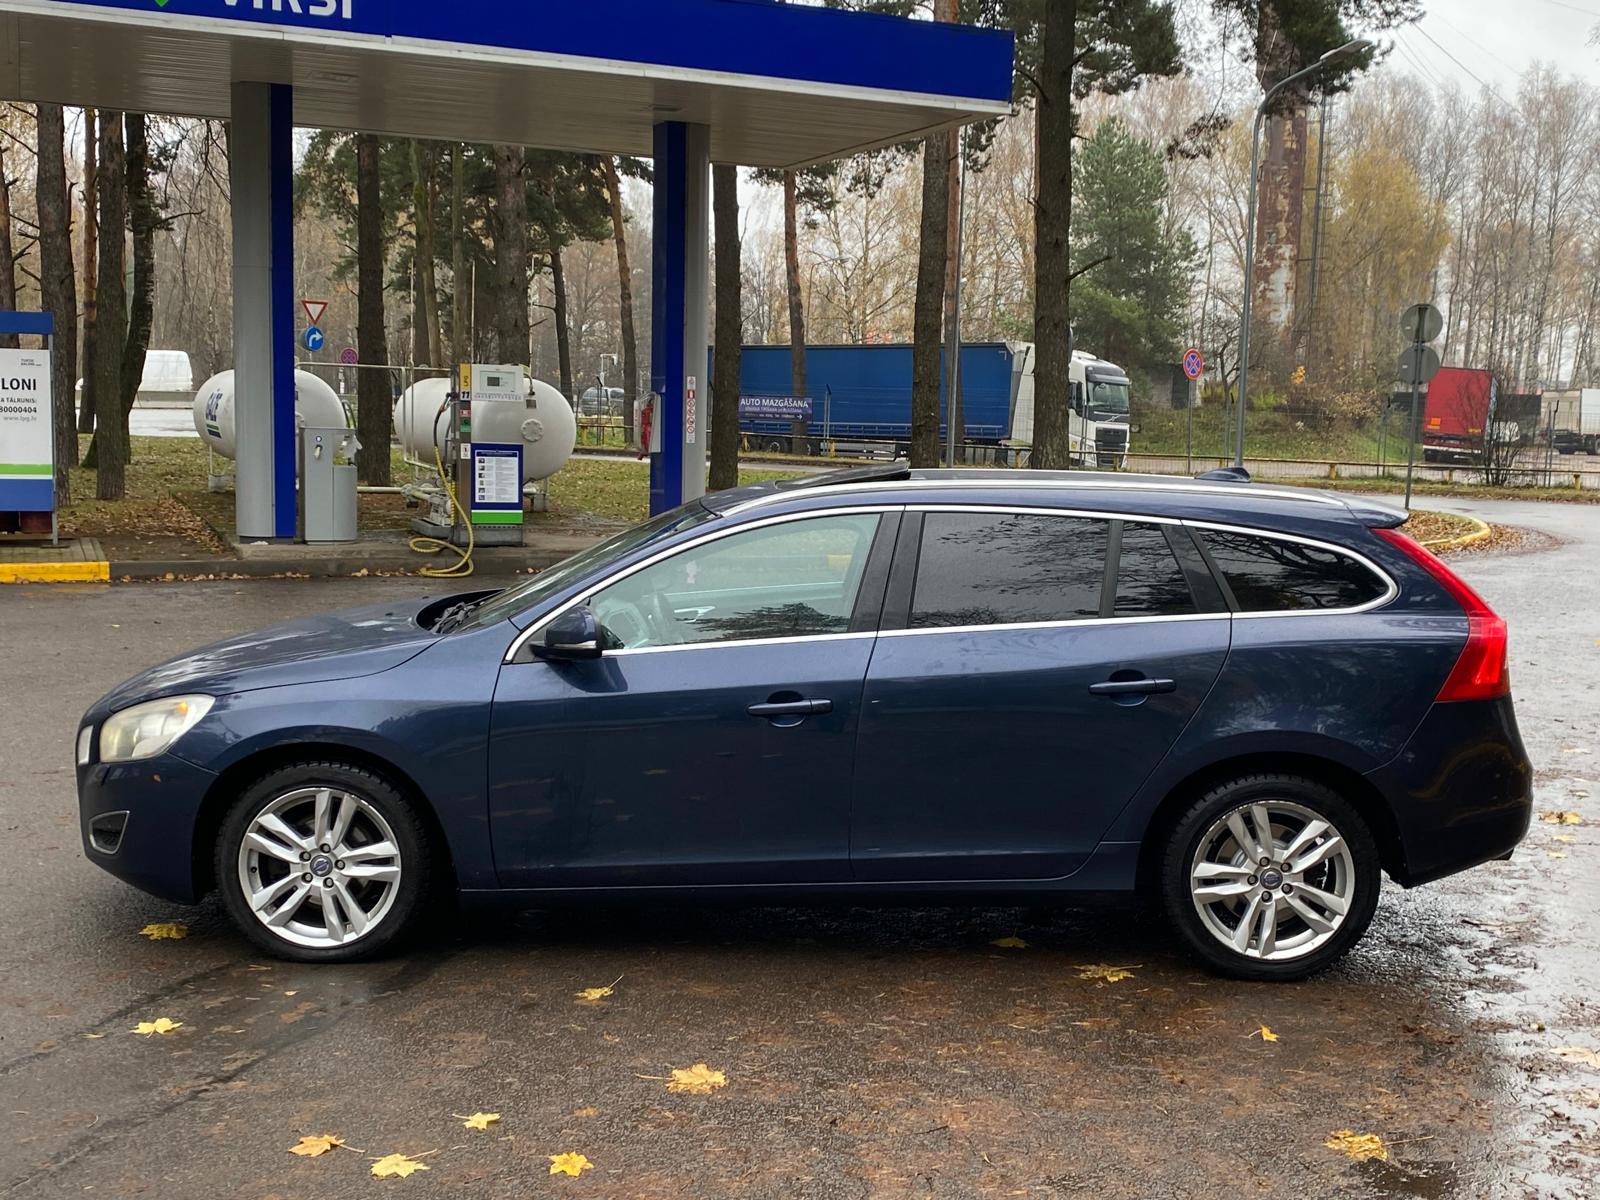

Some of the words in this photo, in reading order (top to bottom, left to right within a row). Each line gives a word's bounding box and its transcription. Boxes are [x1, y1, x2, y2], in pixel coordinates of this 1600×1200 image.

[2, 378, 36, 390] LONI
[740, 398, 761, 406] AUTO
[762, 398, 808, 408] MAZGĀŠANA
